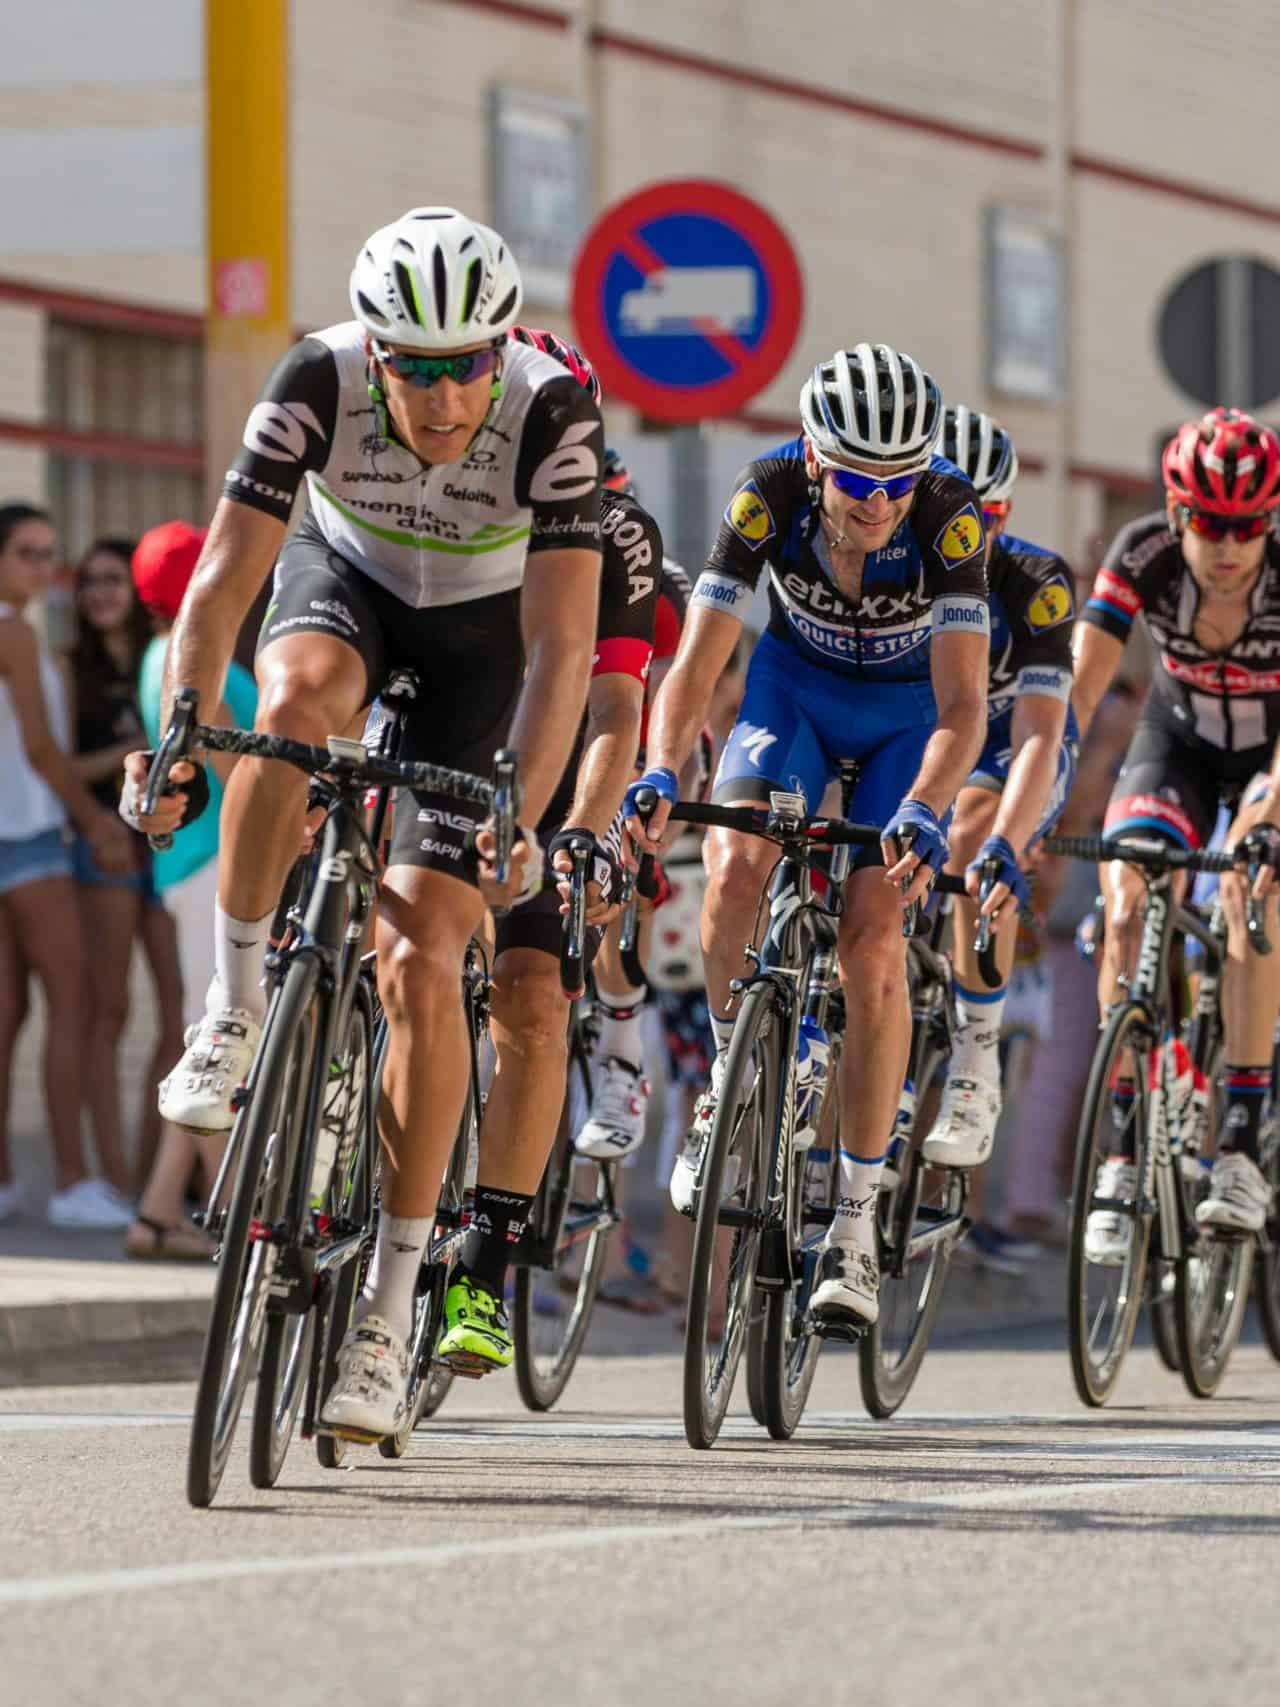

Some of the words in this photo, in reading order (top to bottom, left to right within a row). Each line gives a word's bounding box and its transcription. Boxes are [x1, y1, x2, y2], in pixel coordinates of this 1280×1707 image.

[474, 268, 500, 324] MET
[443, 483, 497, 508] Deloitte
[343, 498, 459, 531] mension
[397, 517, 461, 541] data
[600, 508, 654, 605] BORA
[1136, 895, 1167, 993] GIANT
[481, 1191, 527, 1207] CRAFT
